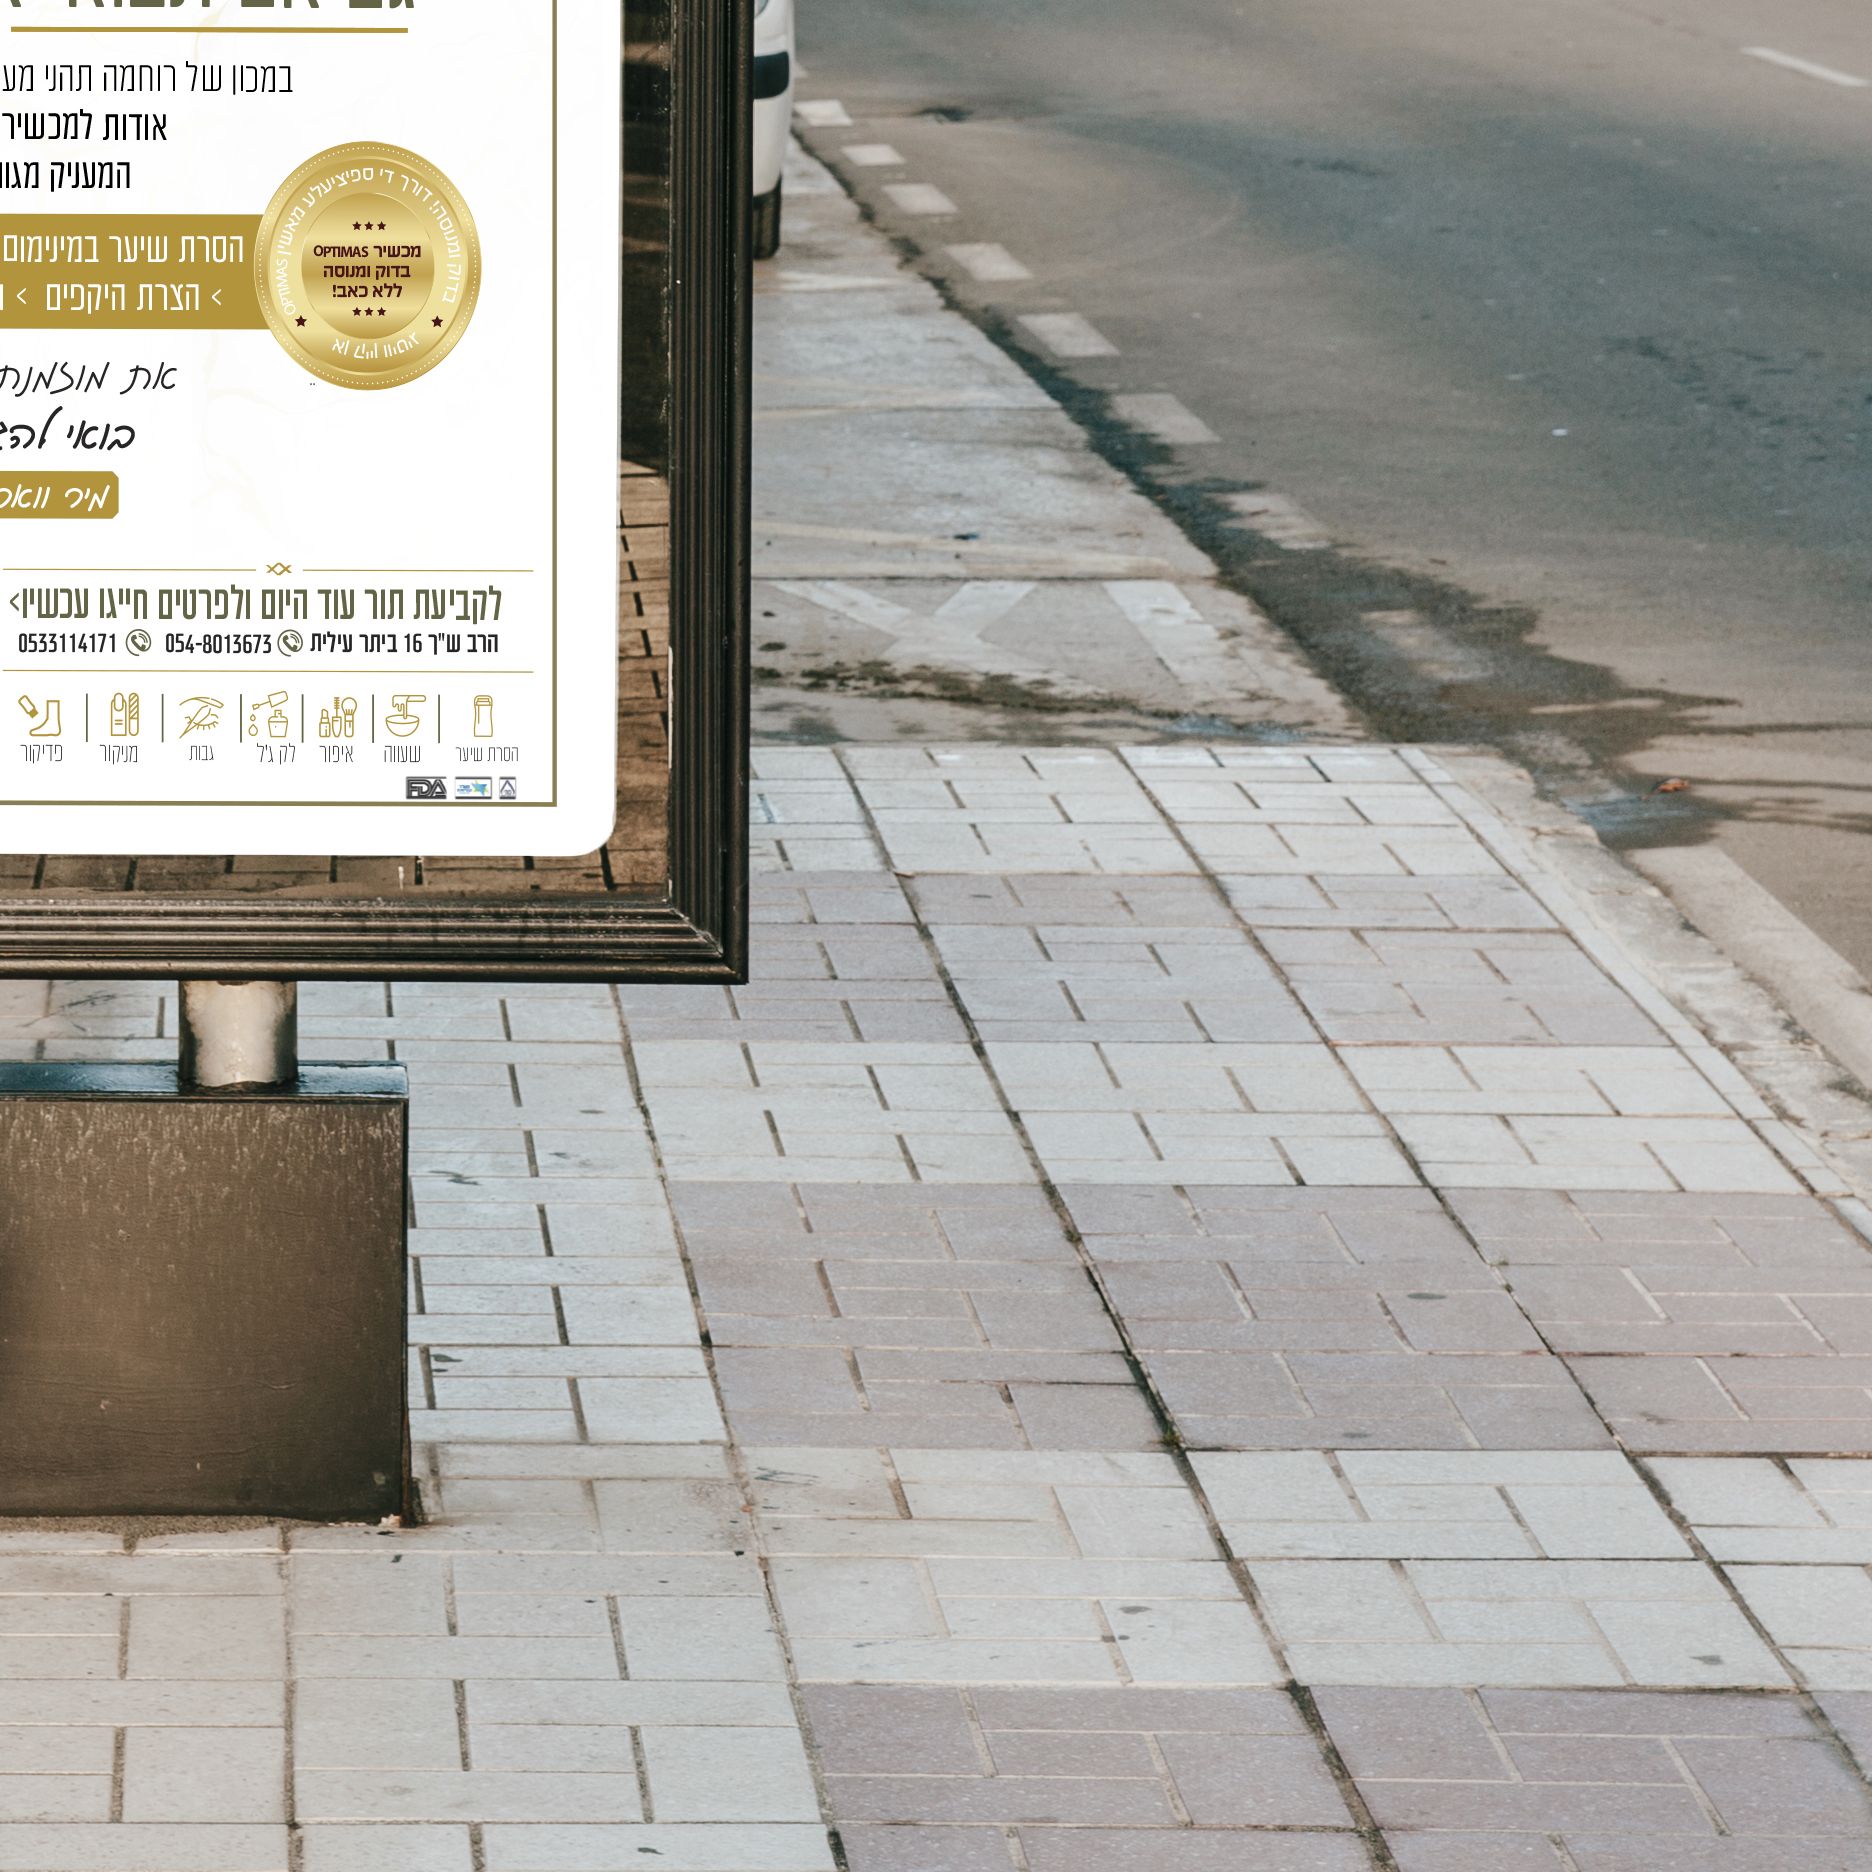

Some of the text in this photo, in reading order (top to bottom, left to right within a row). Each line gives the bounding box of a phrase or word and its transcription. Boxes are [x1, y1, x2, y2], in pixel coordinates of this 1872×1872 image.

[45, 64, 92, 92] תהני
[103, 64, 176, 92] רוחמה
[185, 60, 222, 92] של
[232, 64, 294, 96] במכון
[1, 108, 93, 140] למכשיר
[102, 113, 167, 141] אודות
[50, 160, 131, 193] המעניק
[379, 168, 395, 184] די
[400, 174, 433, 203] דורך
[3, 234, 100, 263] במינימום
[108, 235, 168, 263] שיער
[178, 235, 243, 263] הסרת
[313, 244, 422, 259] מכשיר OPTIMAS
[276, 257, 297, 316] OPTIMAS
[322, 264, 411, 281] בדוק ומנוסה
[442, 263, 462, 304] בדוק
[46, 283, 125, 315] היקפים
[136, 283, 200, 311] הצרת
[332, 282, 403, 299] ללא כאב!
[119, 361, 178, 395] את
[66, 424, 137, 451] בואי
[99, 588, 148, 620] חייגו
[158, 584, 251, 620] ולפרטים
[261, 589, 308, 620] היום
[317, 589, 355, 620] עוד
[364, 589, 404, 620] תור
[413, 585, 502, 625] לקביעת
[18, 630, 499, 656] הרב ש"ך 16 ביתר עילית 054-8013673 0533114171
[19, 744, 64, 765] פדיקור
[99, 744, 139, 765] מניקור
[188, 745, 215, 762] גבות
[279, 743, 297, 765] לק
[319, 745, 355, 763] איפור
[383, 745, 422, 764] שעווה
[455, 746, 519, 762] הסרת שיער
[406, 777, 447, 799] FDA
